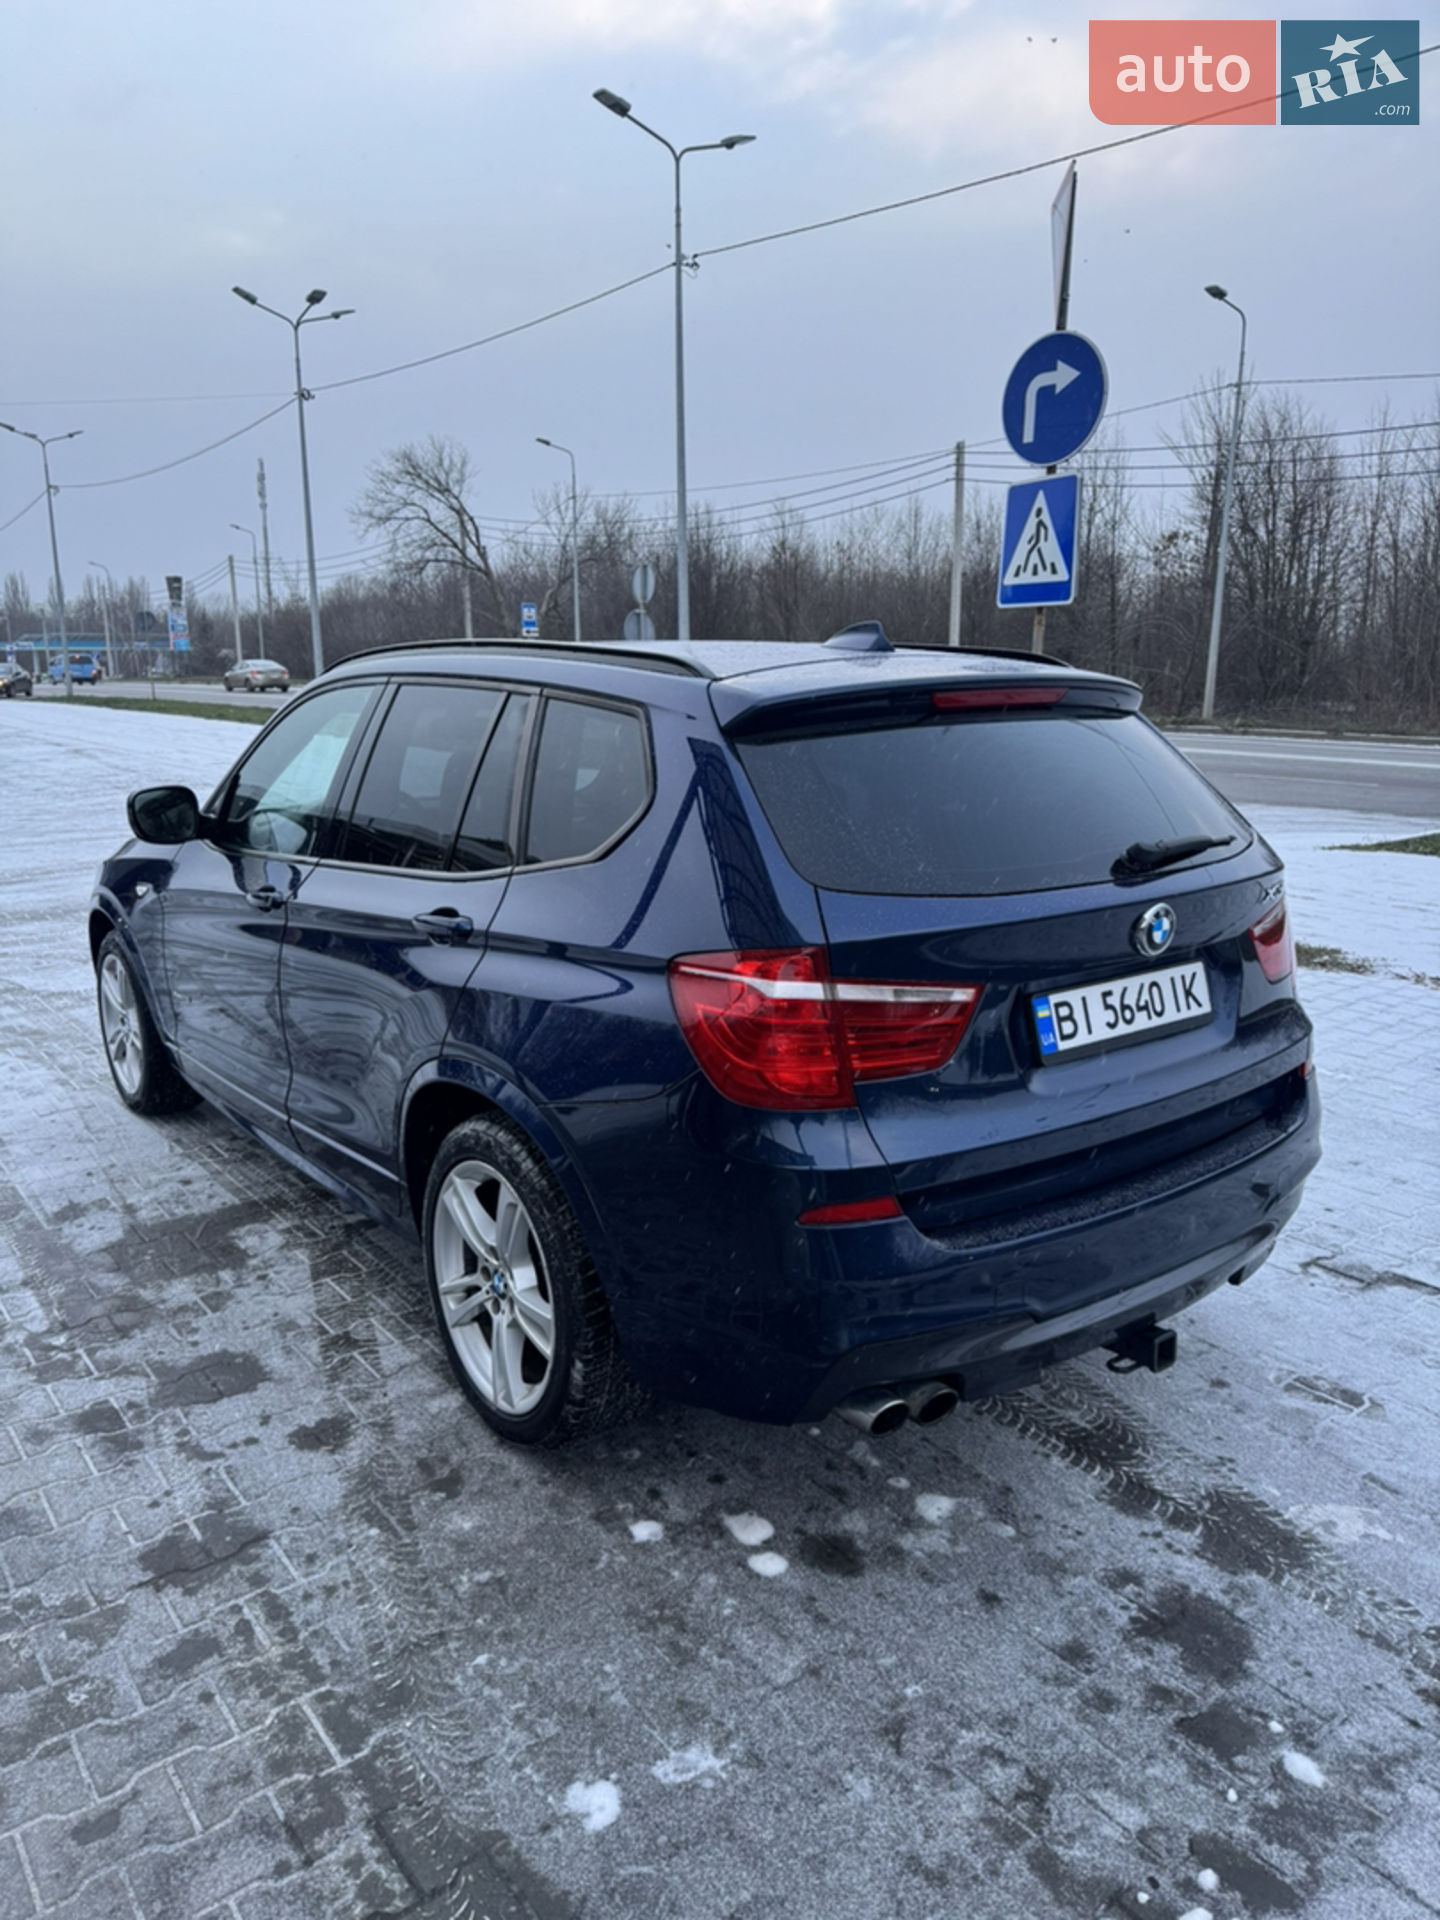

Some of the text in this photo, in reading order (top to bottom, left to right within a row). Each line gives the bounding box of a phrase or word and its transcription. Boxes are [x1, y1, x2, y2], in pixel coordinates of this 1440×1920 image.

[1053, 972, 1202, 1042] BI 5640 IK
